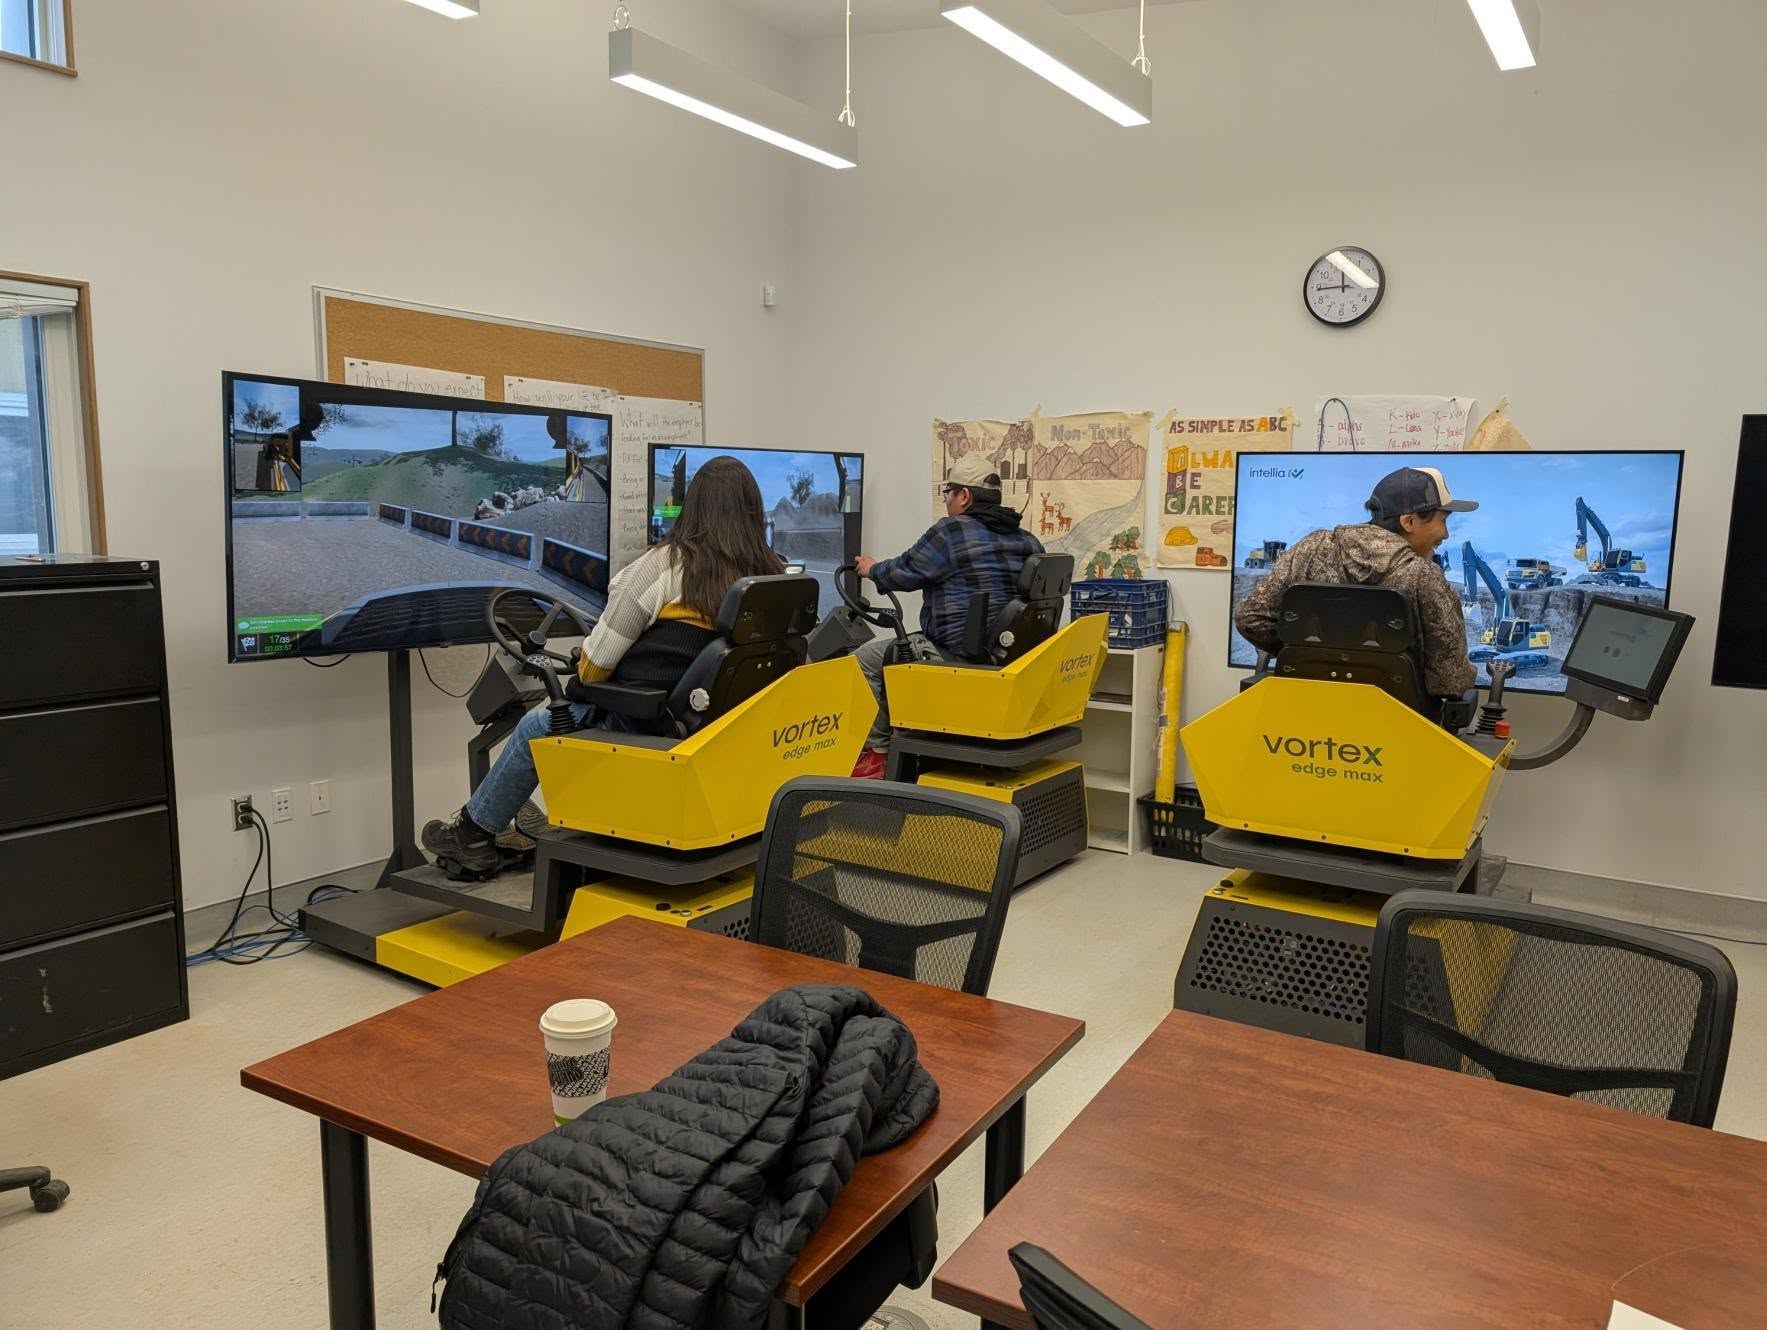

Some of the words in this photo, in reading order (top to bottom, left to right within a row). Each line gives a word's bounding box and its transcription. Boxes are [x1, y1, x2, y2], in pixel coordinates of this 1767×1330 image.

[1320, 271, 1329, 280] 10
[1318, 296, 1324, 304] 8
[1361, 295, 1368, 303] 4
[1327, 305, 1332, 313] 7
[1338, 308, 1345, 317] 6
[1352, 304, 1358, 313] 5
[620, 408, 643, 429] What
[1389, 408, 1398, 421] K
[1050, 423, 1132, 441] Non-Toxic
[1169, 421, 1184, 434] AS
[1187, 419, 1235, 434] SIMPLE
[1238, 419, 1255, 432] AS
[1256, 416, 1288, 432] ABC
[1389, 424, 1398, 434] L
[1176, 448, 1234, 469] ALWA
[1249, 467, 1286, 478] intellia
[1167, 495, 1235, 516] CAREF
[270, 634, 291, 644] 17/35
[1060, 653, 1095, 673] vortex
[772, 711, 845, 749] vortex
[782, 743, 811, 760] edge
[813, 736, 838, 752] max
[1262, 734, 1384, 767] vortex
[1291, 762, 1338, 779] edge
[1343, 768, 1384, 784] max
